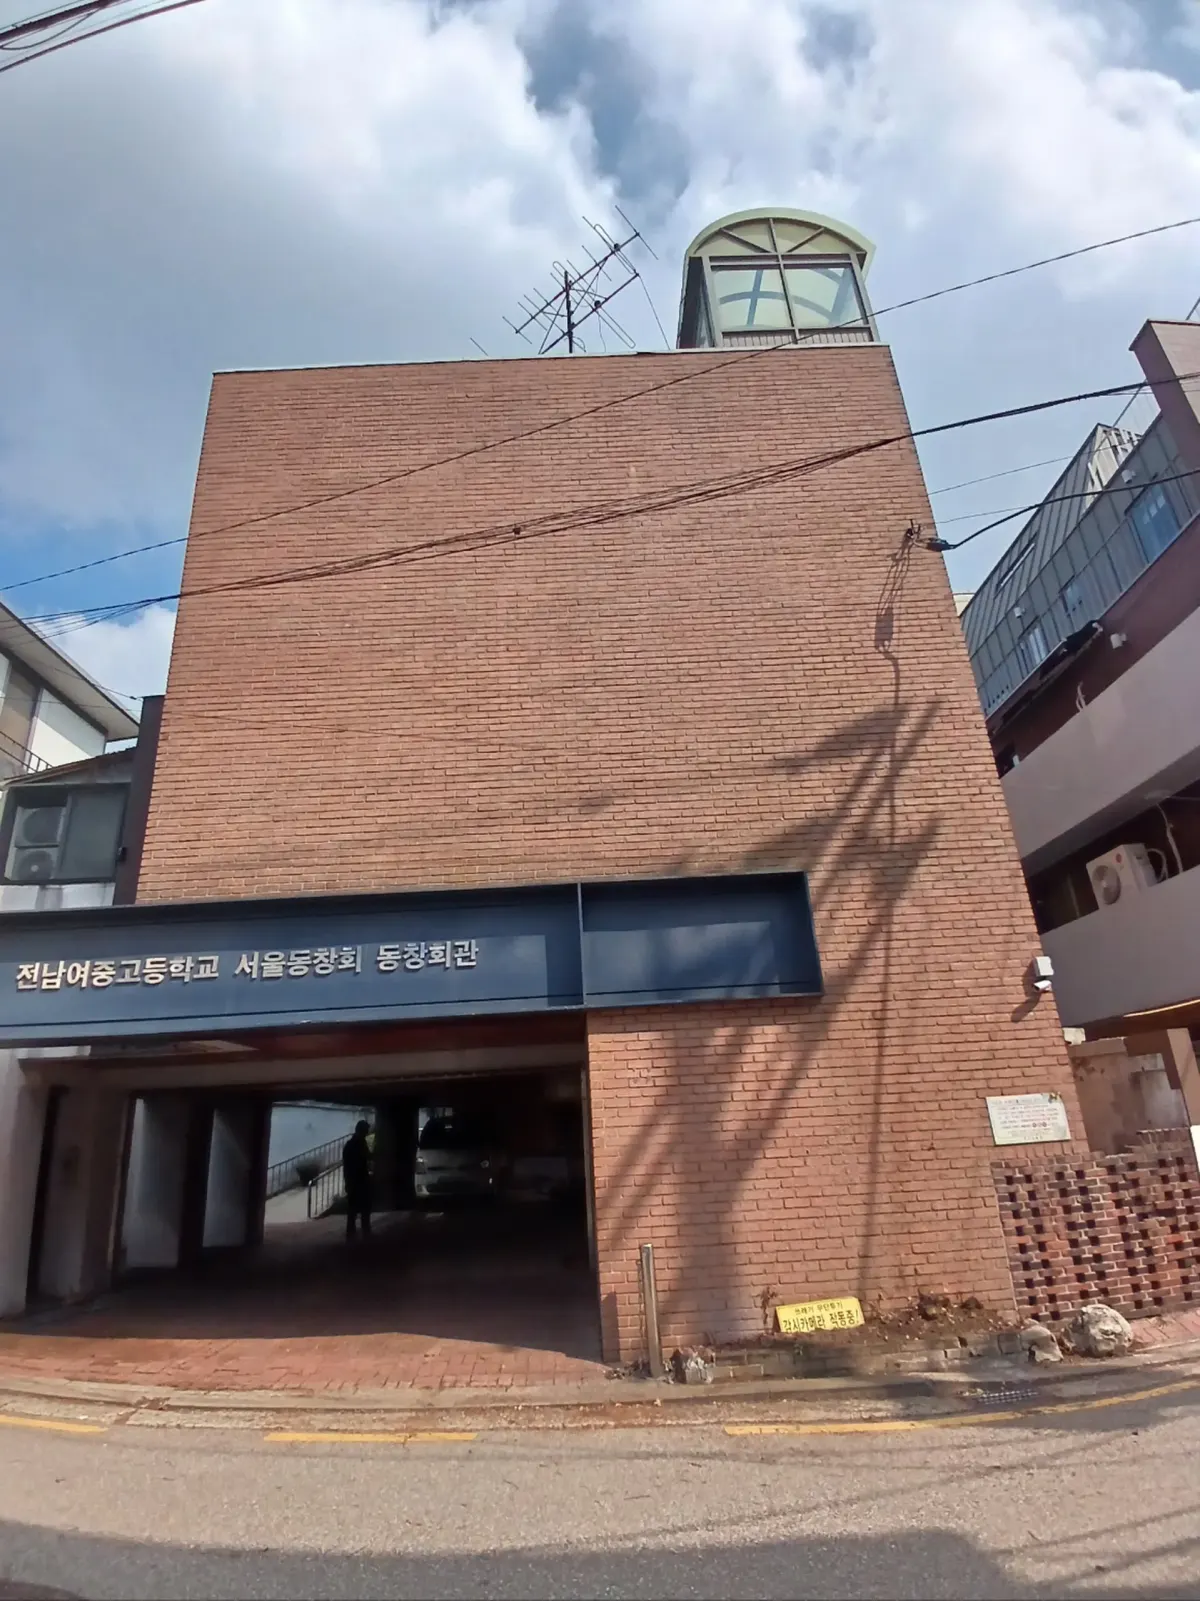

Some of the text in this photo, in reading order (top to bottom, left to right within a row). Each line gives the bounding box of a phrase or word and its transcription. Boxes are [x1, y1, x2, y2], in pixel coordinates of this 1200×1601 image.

[16, 939, 479, 990] 전남여중고등학교 서울동창회 동창회관
[794, 1306, 814, 1316] 쓰레기
[829, 1309, 859, 1327] 작동중!
